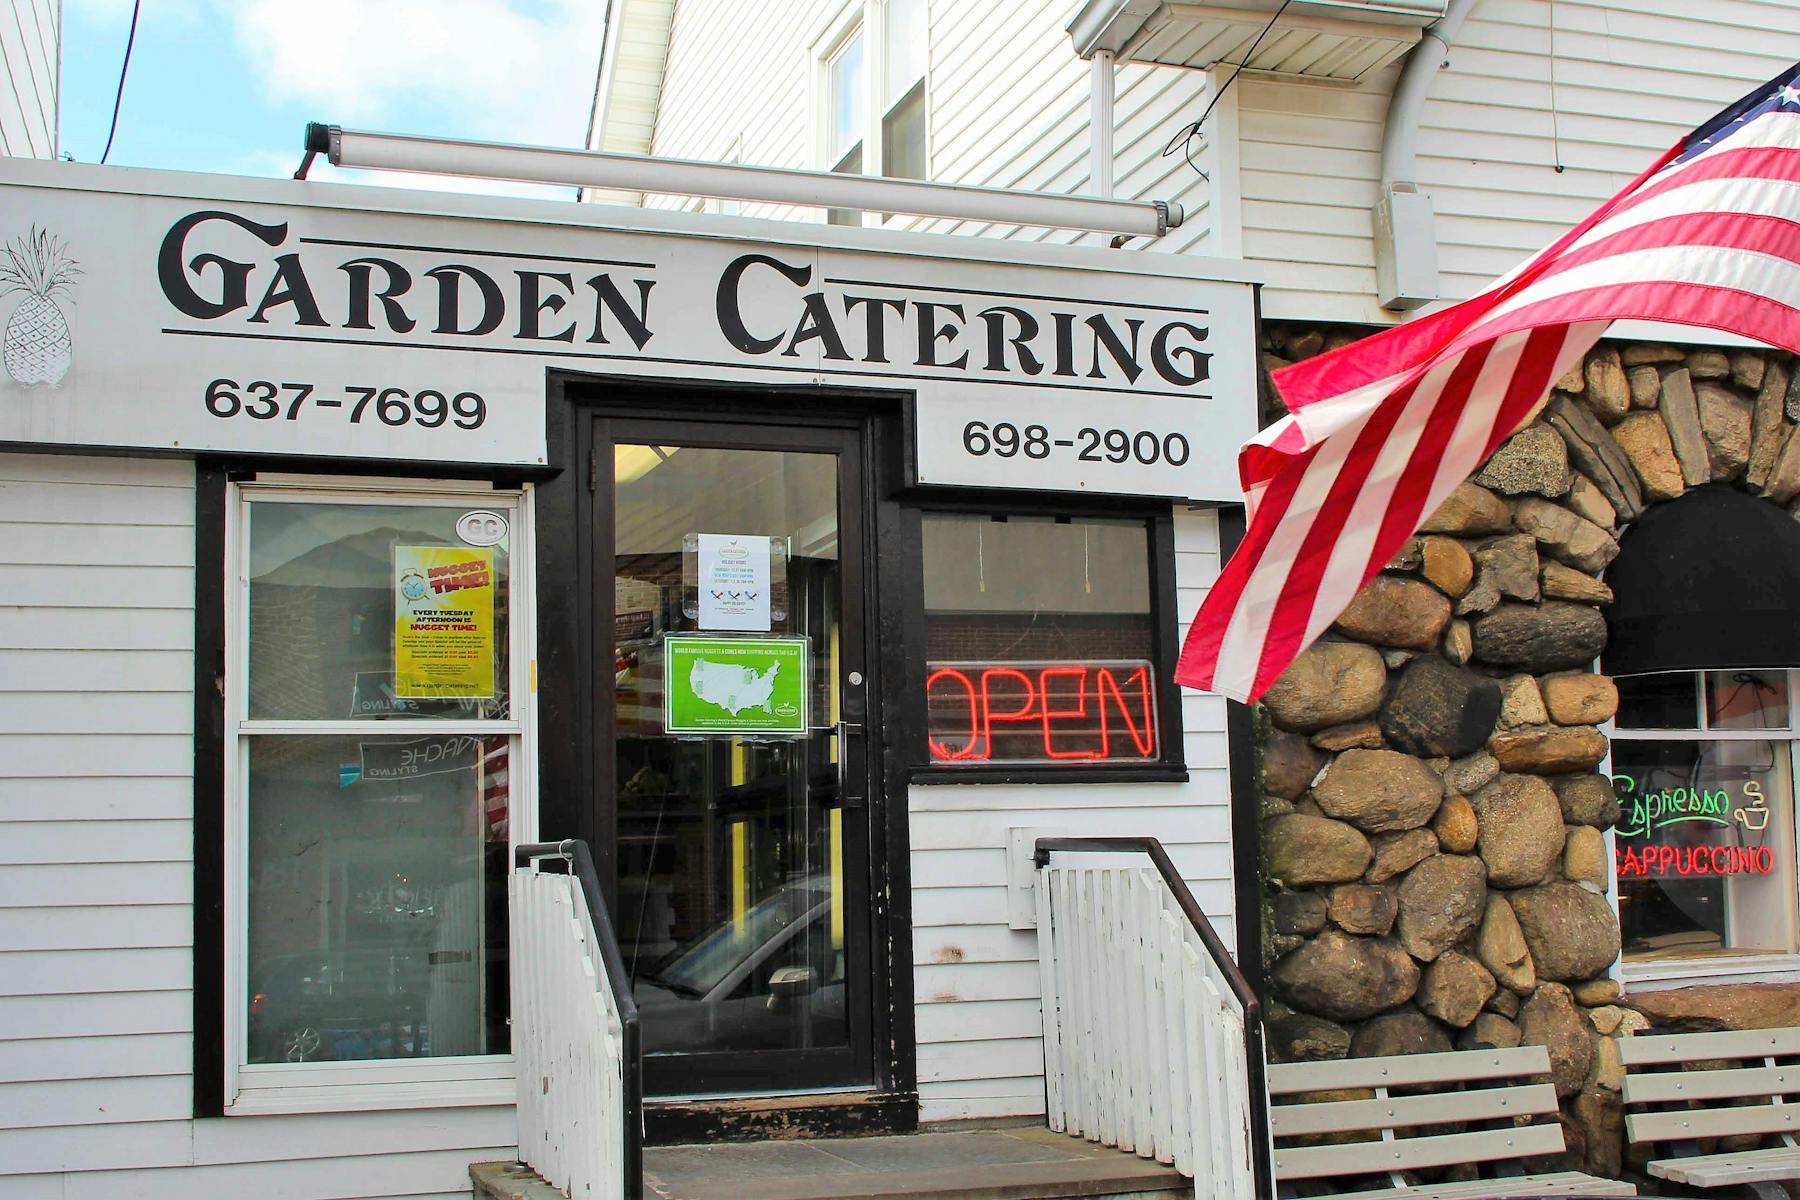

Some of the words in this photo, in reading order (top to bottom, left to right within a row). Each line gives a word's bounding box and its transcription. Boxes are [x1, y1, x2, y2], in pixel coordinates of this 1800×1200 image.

[157, 210, 656, 352] GARDEN
[716, 254, 1215, 387] CATERING
[204, 378, 486, 430] 637-7699
[963, 420, 1190, 467] 698-2900
[427, 560, 486, 578] NUGGET
[410, 623, 450, 631] NUGGET
[926, 666, 1152, 760] OPEN
